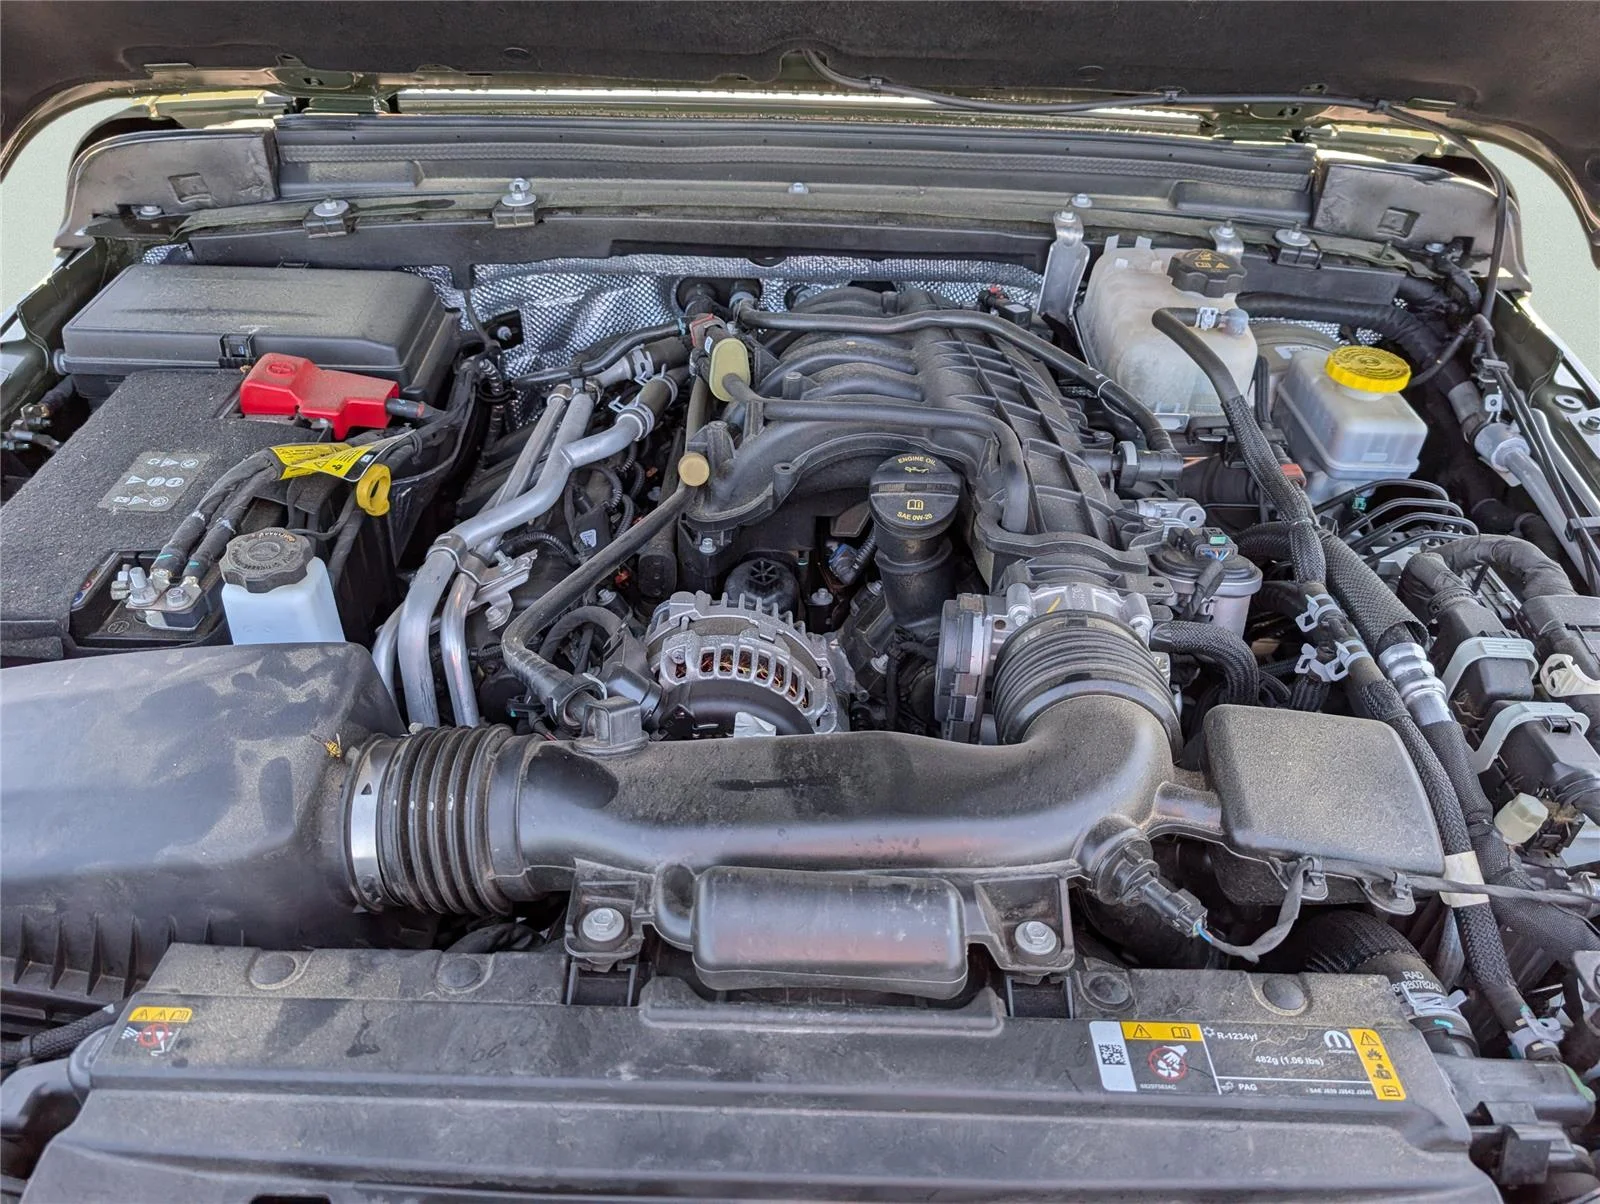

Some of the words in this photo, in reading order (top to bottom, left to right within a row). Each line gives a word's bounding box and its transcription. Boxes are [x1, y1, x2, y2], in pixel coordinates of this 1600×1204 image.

[897, 455, 924, 464] ENGINE
[925, 457, 936, 467] OIL
[897, 511, 911, 520] SAE
[912, 513, 933, 521] 0W-20
[1402, 970, 1424, 980] RAD
[1255, 1055, 1279, 1065] 482g
[1280, 1055, 1304, 1066] (1.06
[1305, 1056, 1324, 1067] lbs)
[1238, 1083, 1258, 1091] PAG
